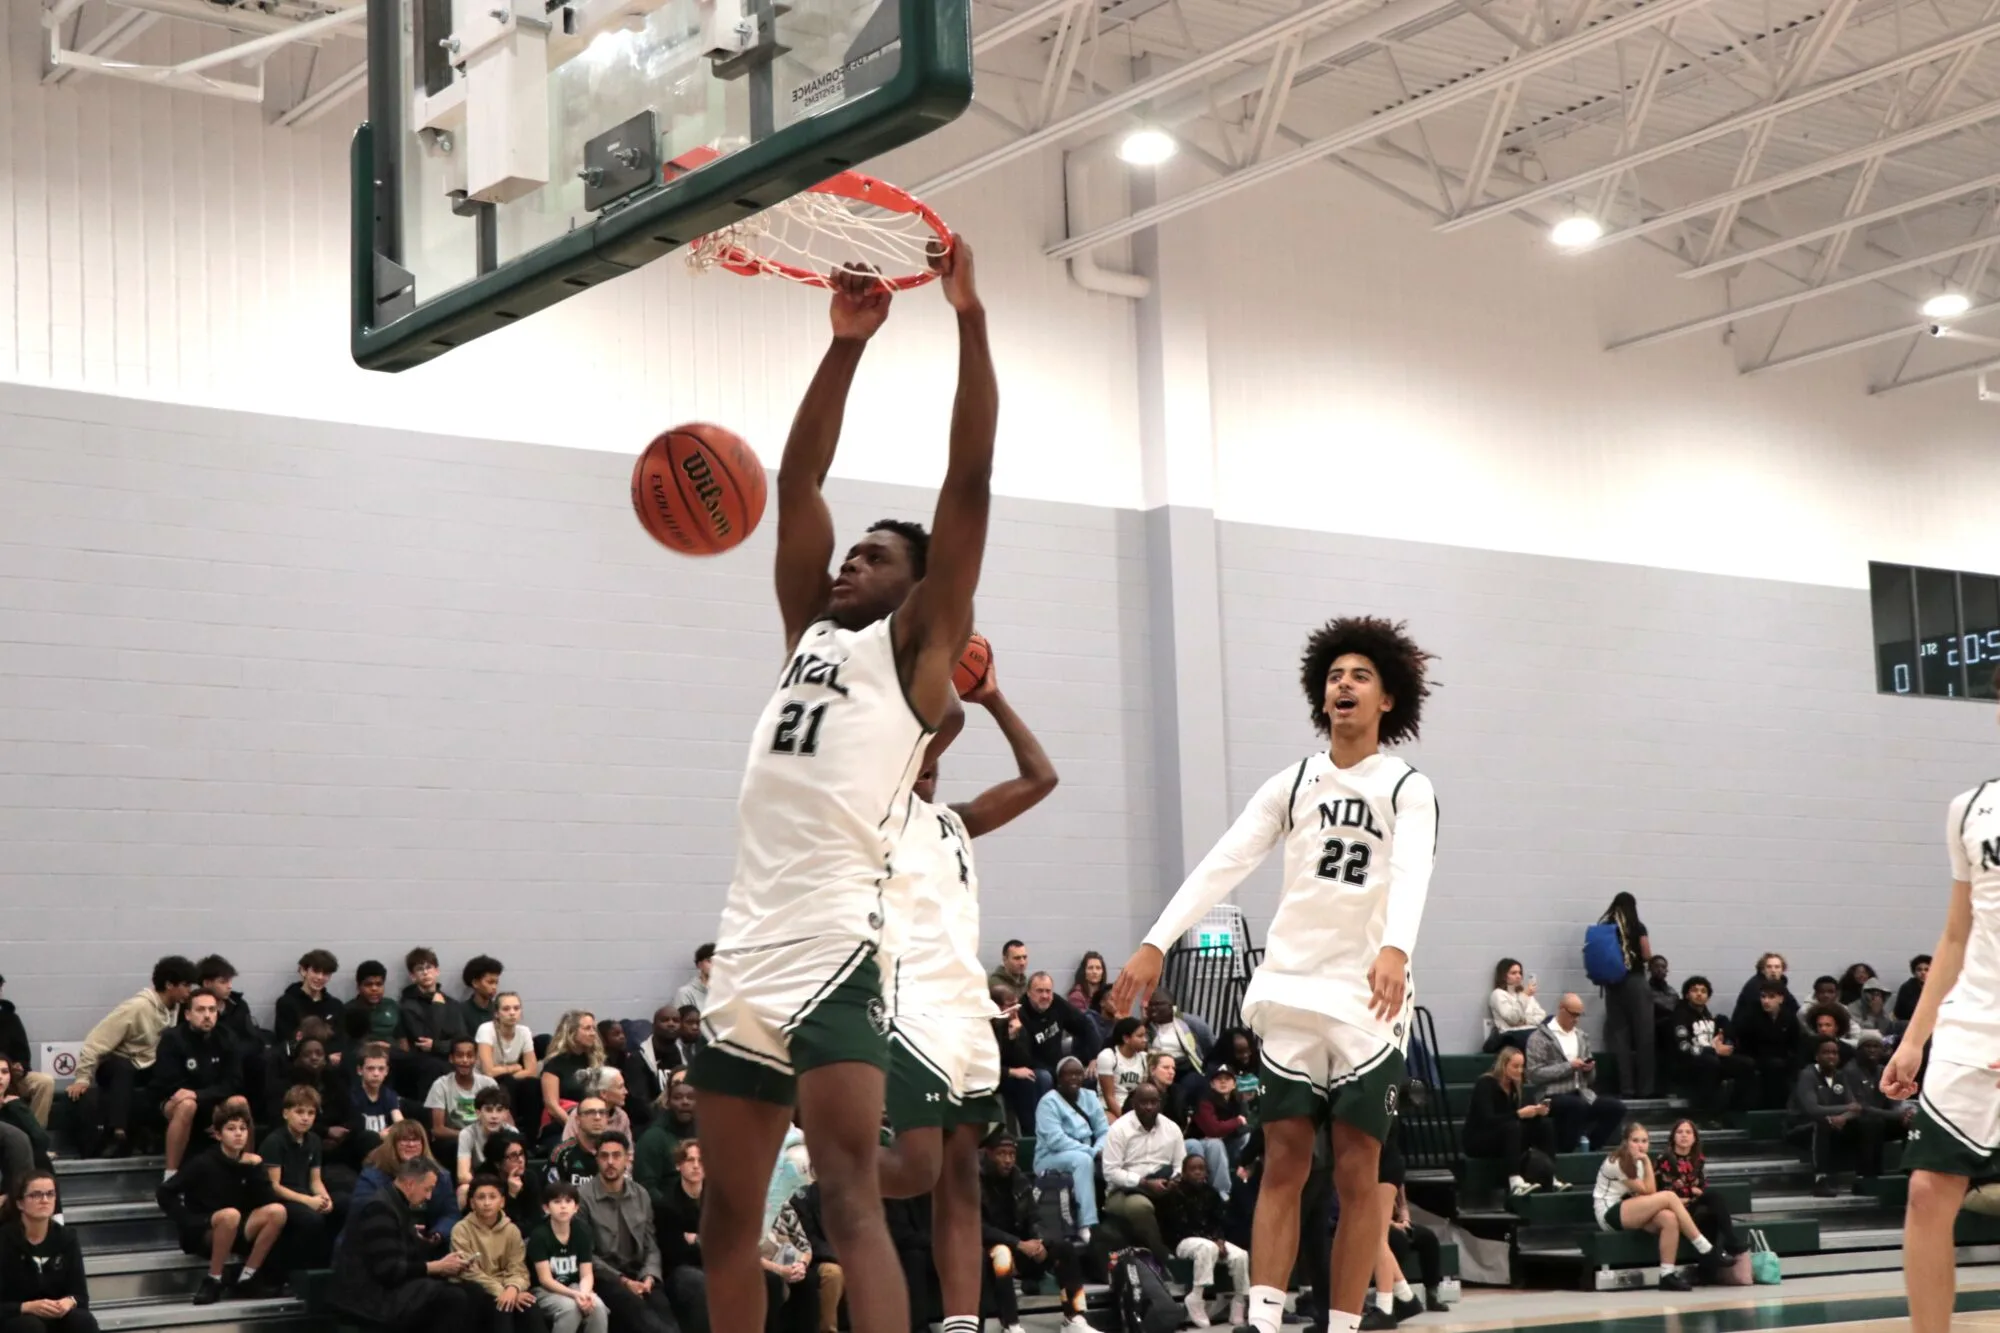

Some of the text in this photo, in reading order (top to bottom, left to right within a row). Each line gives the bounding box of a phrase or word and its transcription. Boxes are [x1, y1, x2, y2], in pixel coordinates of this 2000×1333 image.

[681, 449, 733, 537] Wilson
[769, 700, 829, 757] 21
[1318, 798, 1384, 841] NDL
[1315, 837, 1372, 887] 22
[571, 1173, 593, 1186] Em
